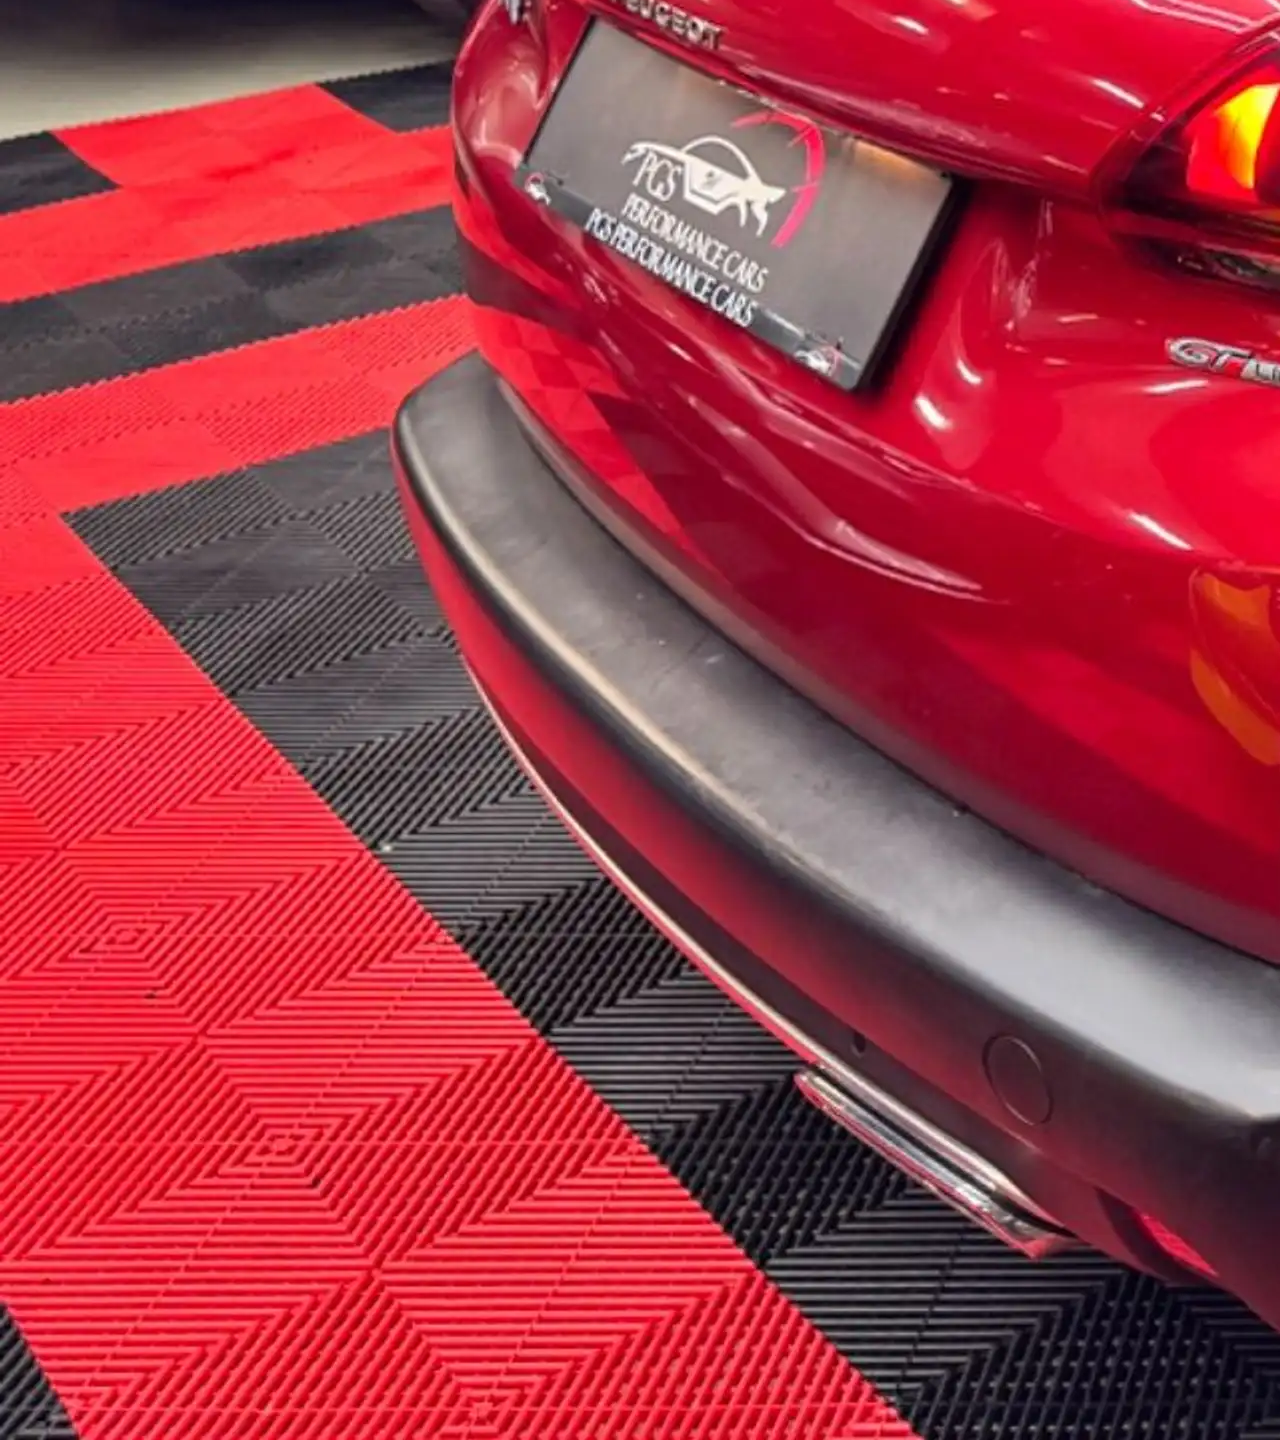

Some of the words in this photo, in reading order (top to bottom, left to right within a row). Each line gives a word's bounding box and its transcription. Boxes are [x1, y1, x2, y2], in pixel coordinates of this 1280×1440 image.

[631, 151, 683, 201] PGS
[584, 208, 618, 241] PGS
[610, 218, 717, 303] PERFORMANCE
[710, 279, 759, 327] CARS
[621, 192, 727, 269] PERFORMANCE
[722, 250, 768, 293] CARS
[1168, 337, 1252, 372] GT
